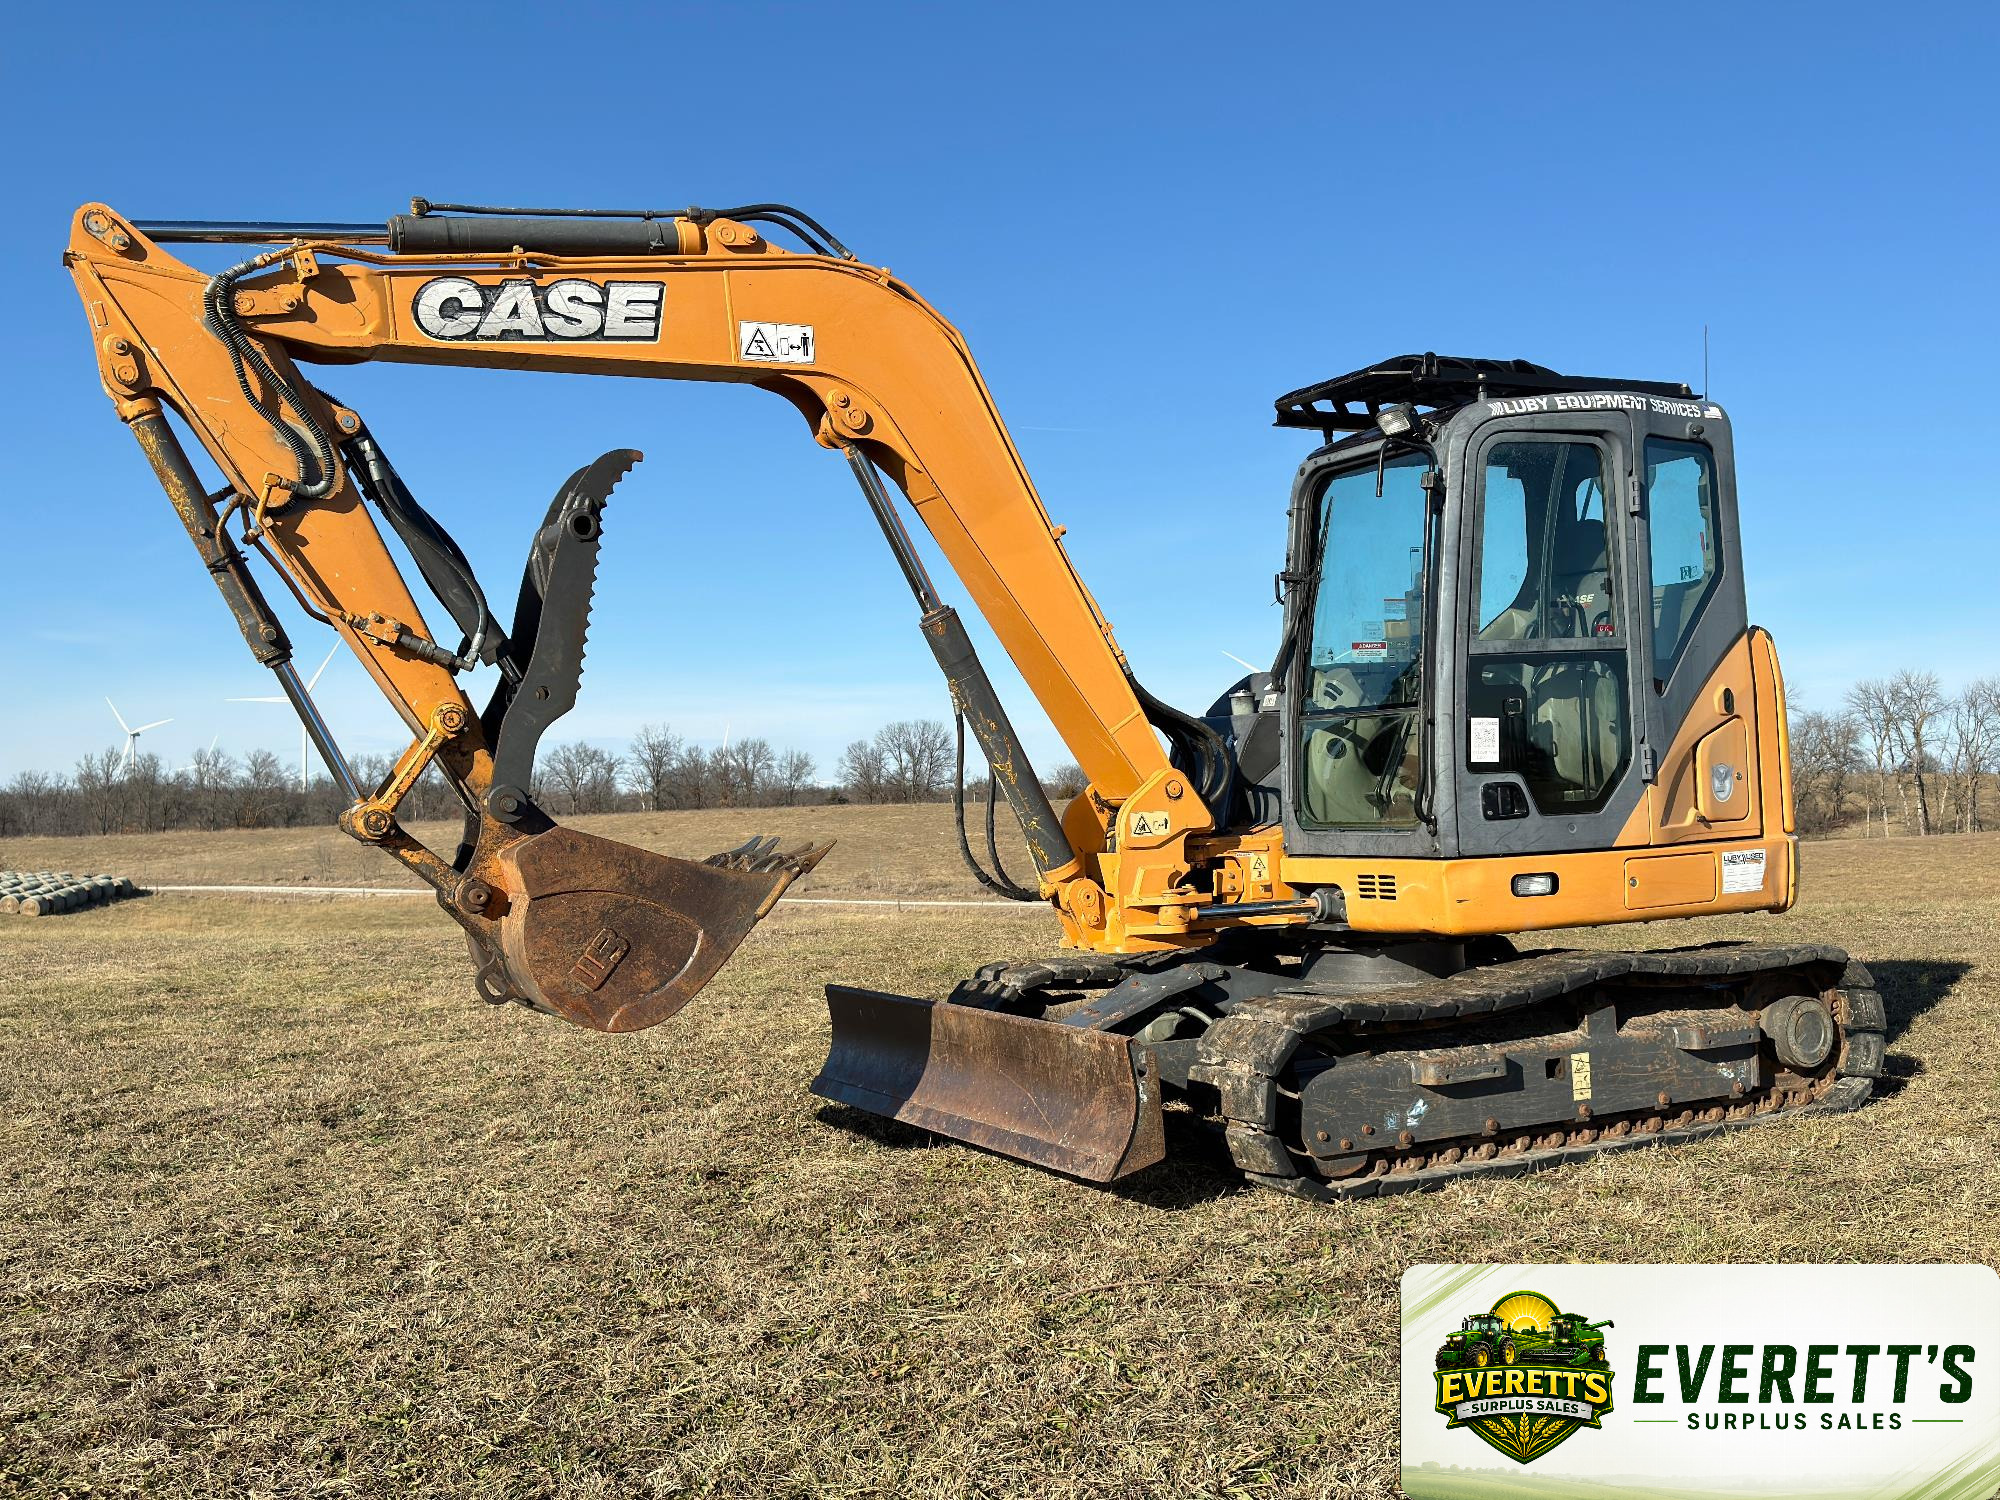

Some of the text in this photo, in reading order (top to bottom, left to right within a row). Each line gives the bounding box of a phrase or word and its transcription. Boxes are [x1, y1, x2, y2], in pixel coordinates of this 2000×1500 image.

[414, 278, 664, 340] CASE
[1503, 394, 1701, 418] LUBY EQUIPMENT SERVICES
